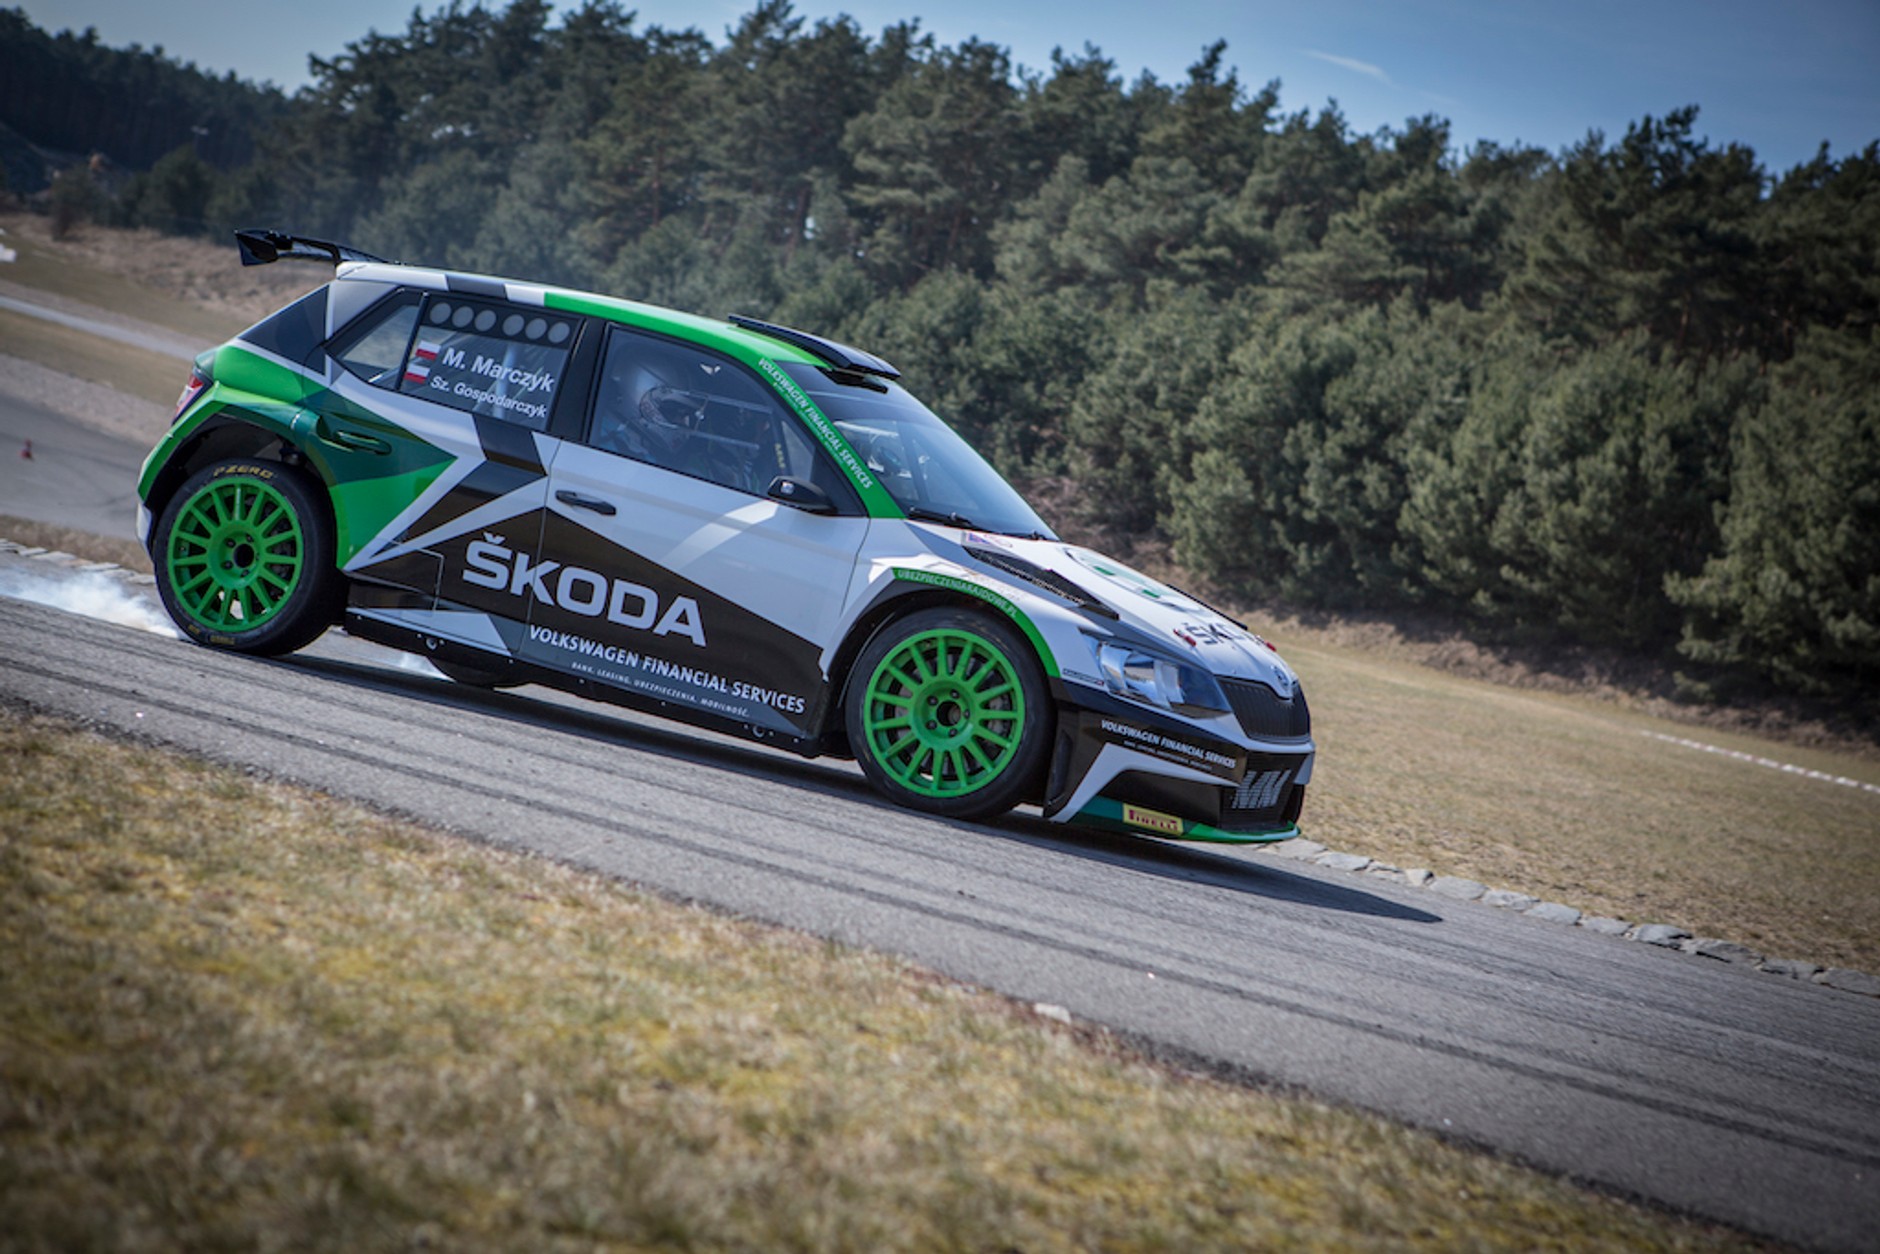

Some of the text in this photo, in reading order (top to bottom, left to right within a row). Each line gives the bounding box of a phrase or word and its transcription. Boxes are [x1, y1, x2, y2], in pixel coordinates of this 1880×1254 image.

[441, 346, 555, 393] M. Marczyk
[430, 374, 547, 418] Sz. Gospodarczyk
[758, 357, 809, 410] VOLKSWAGEN
[805, 404, 842, 452] FINANCIAL
[839, 449, 874, 489] SERVICES
[462, 531, 708, 648] ŠKODA
[528, 623, 806, 715] VOLKSWAGEN FINANCIAL SERVICES
[1100, 718, 1160, 745] VOLKSWAGEN
[1160, 736, 1205, 759] FINANCIAL
[1204, 750, 1237, 770] SERVICES
[1128, 809, 1179, 831] PIRELLI
